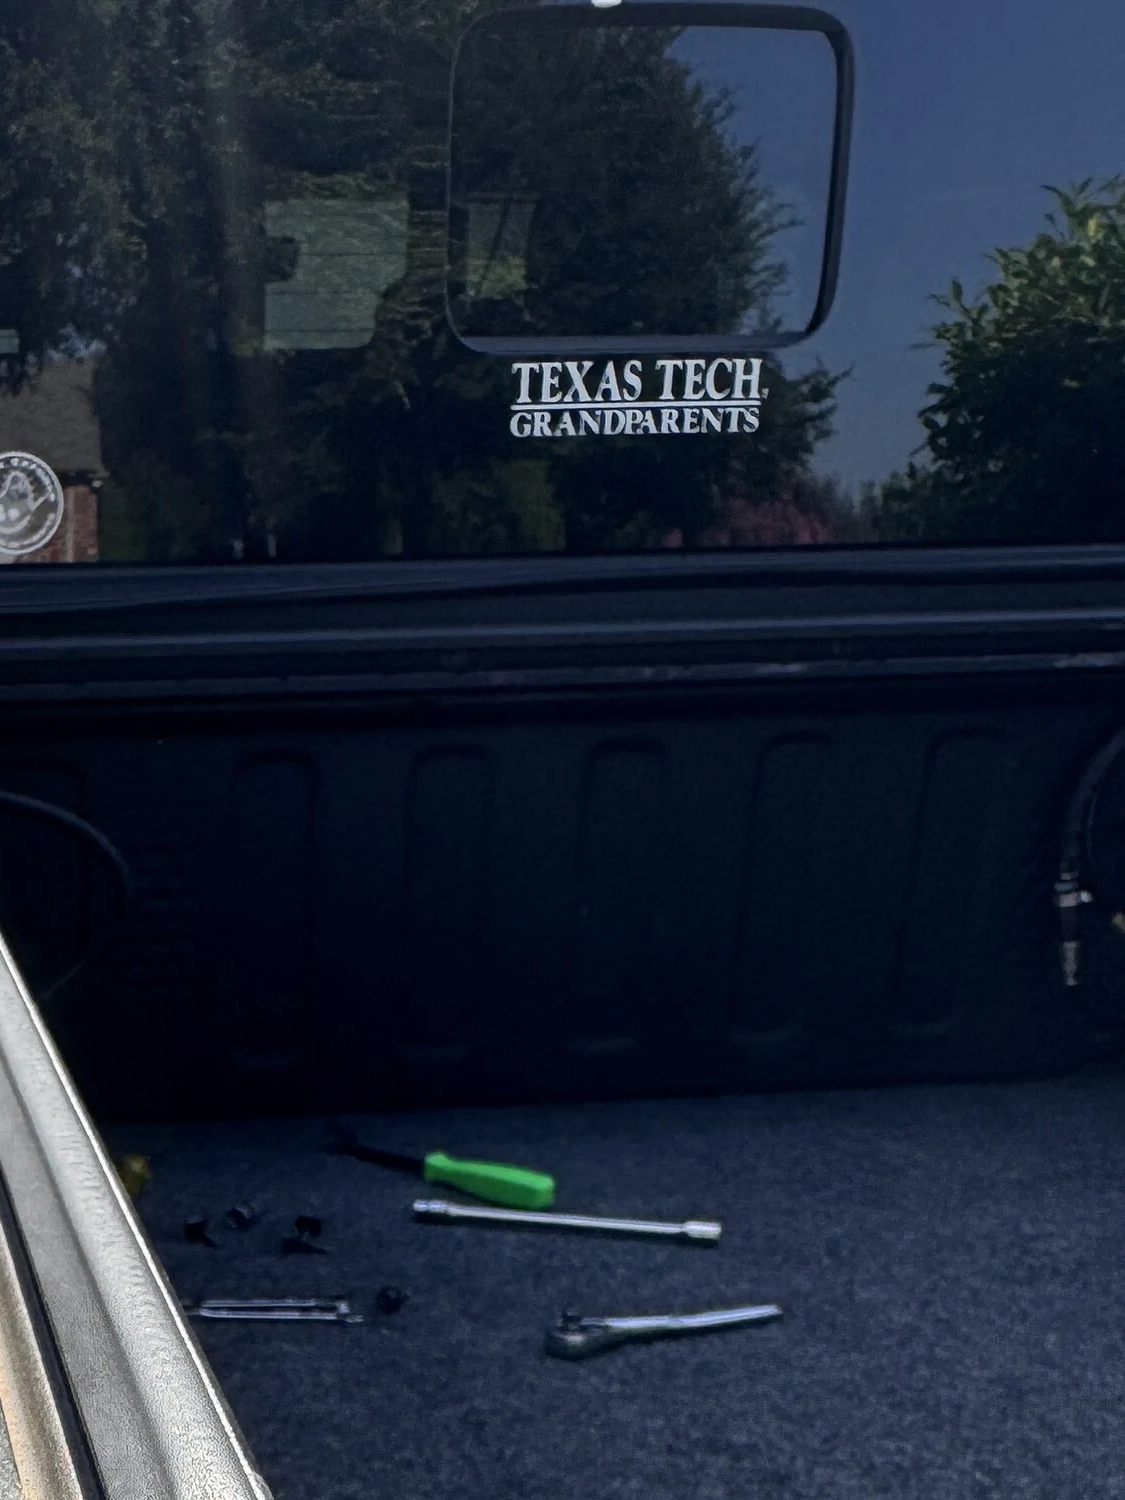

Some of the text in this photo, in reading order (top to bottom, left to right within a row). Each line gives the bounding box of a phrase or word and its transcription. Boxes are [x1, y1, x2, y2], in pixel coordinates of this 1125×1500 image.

[511, 357, 763, 403] TEXAS TECH
[509, 406, 761, 437] GRANDPARENTS
